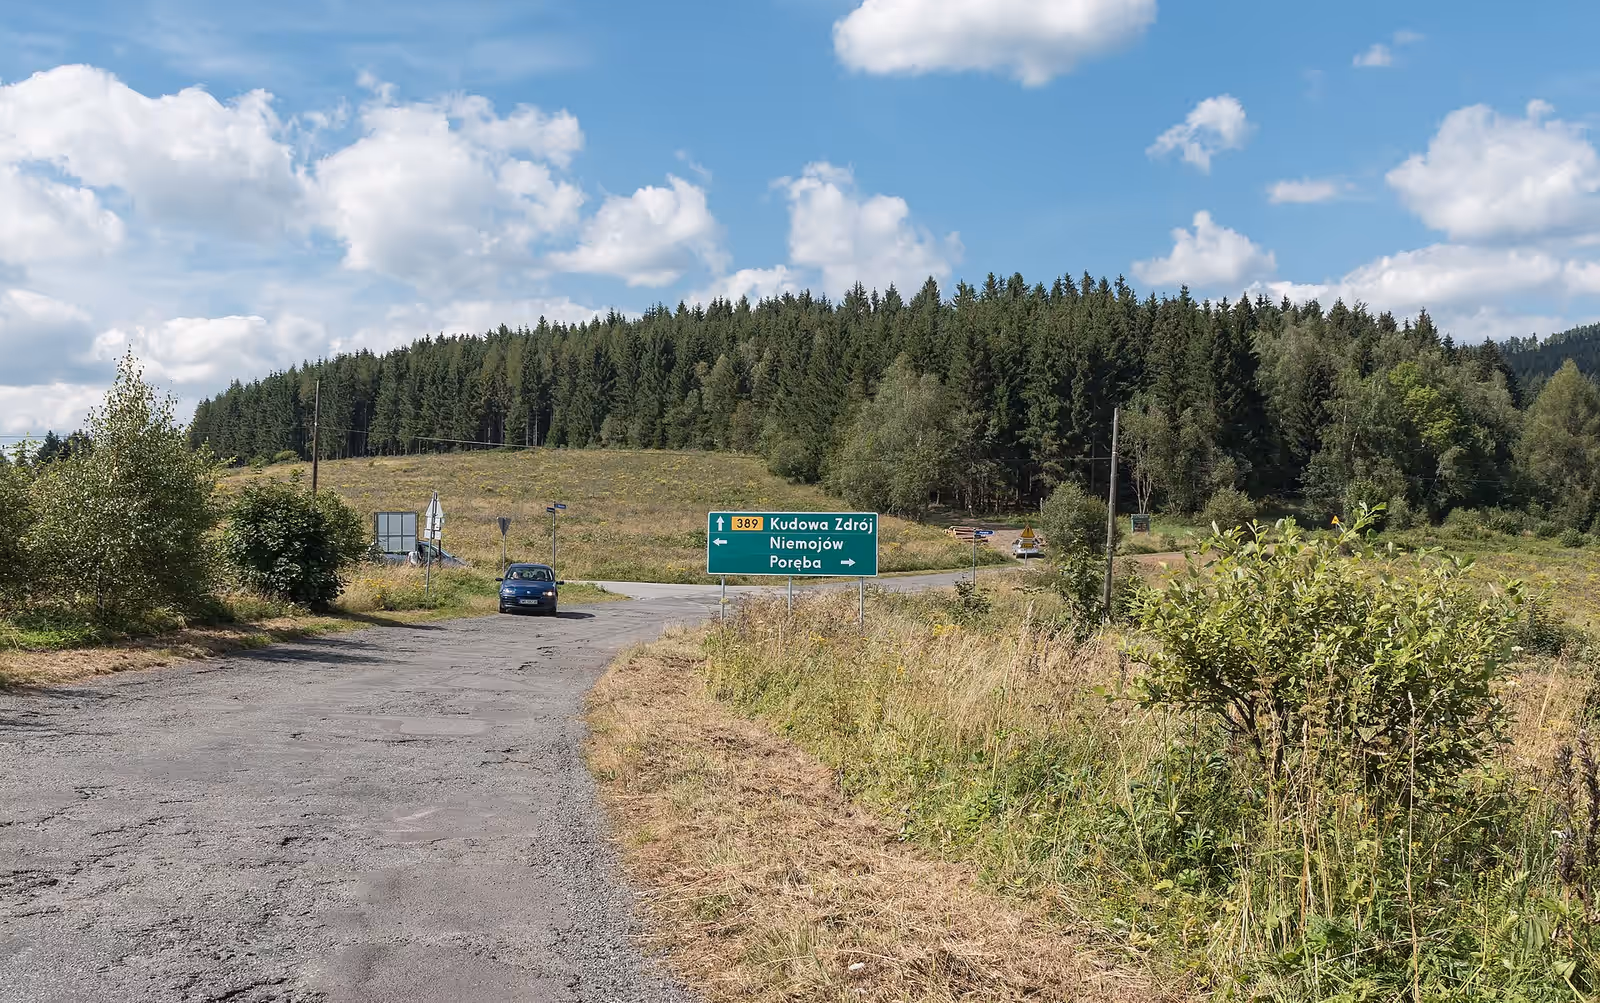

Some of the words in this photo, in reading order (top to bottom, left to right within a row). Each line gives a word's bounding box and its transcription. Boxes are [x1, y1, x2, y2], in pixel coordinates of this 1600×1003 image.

[736, 518, 759, 529] 389
[770, 517, 829, 531] Kudowa
[835, 517, 873, 534] Zdrój
[770, 536, 844, 553] Niemojów
[770, 555, 822, 571] Poręba
